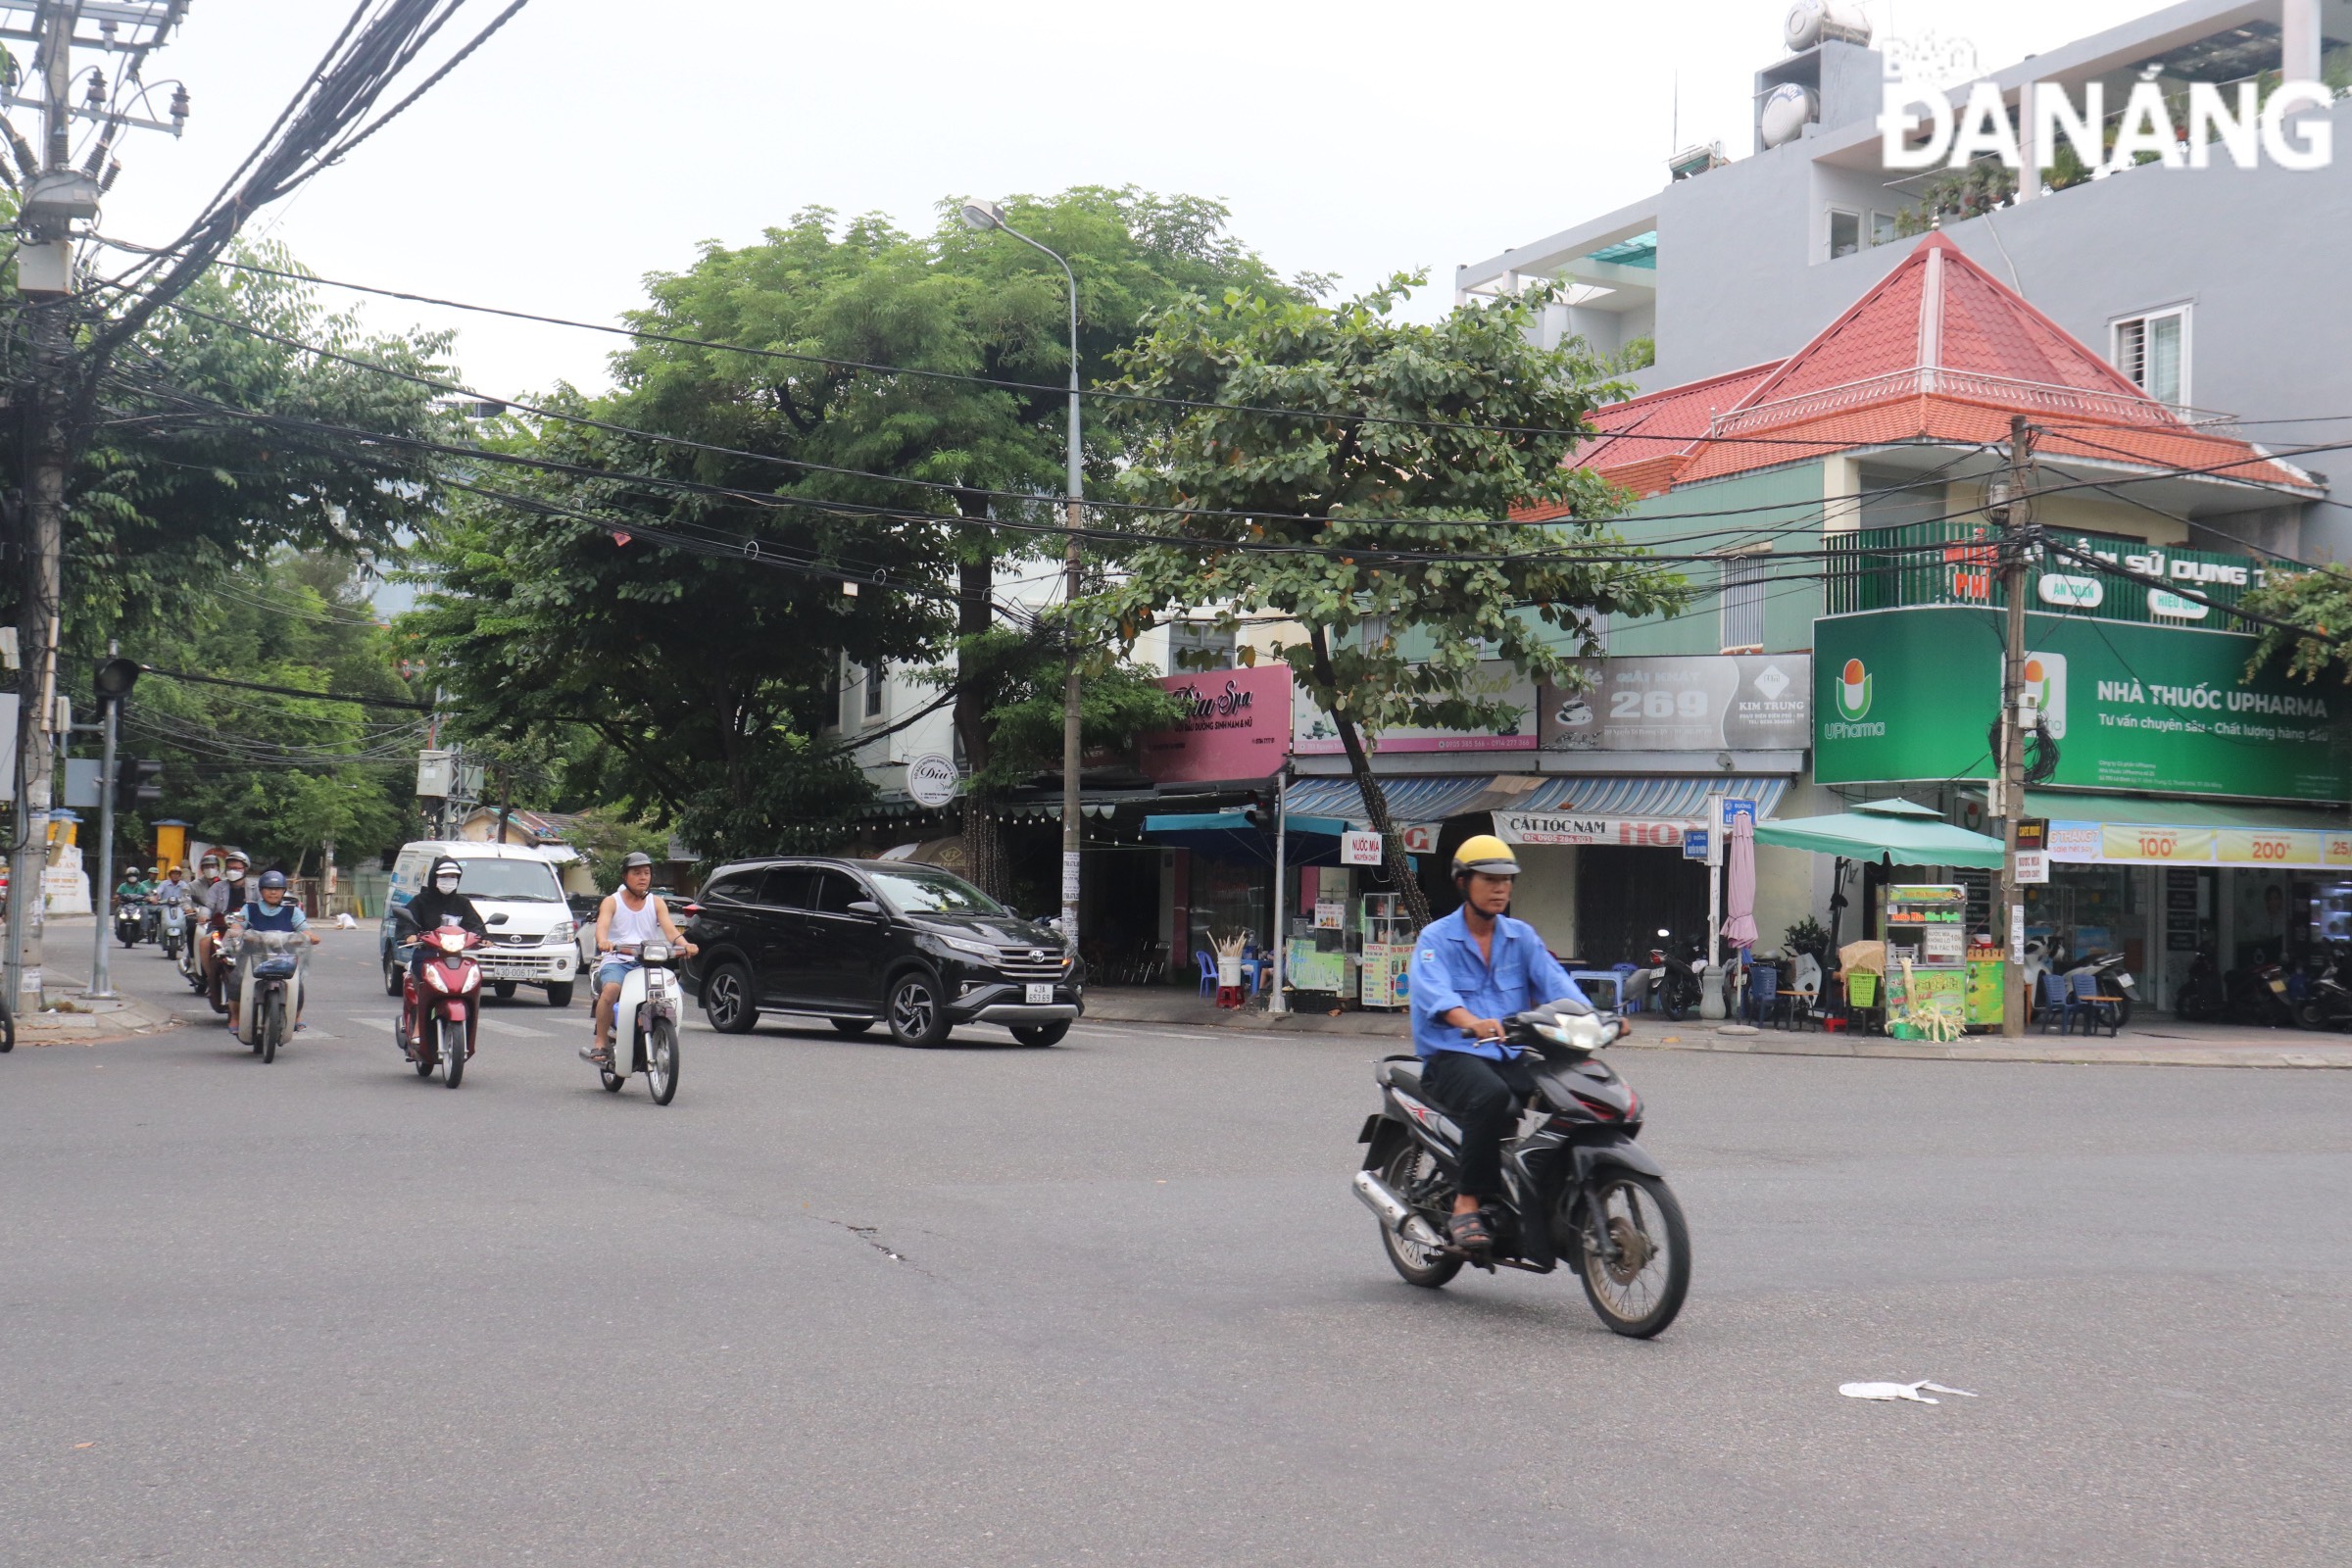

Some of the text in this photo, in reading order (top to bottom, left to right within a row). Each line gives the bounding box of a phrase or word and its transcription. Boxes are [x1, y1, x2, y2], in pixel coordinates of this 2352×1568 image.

[2125, 550, 2165, 576] SỬ
[2171, 560, 2247, 586] DỤNG
[2054, 581, 2094, 599] AN TOÀN
[2158, 594, 2179, 610] HIỆU
[1218, 679, 1253, 715] Spa
[1610, 690, 1708, 718] 269
[1739, 701, 1805, 710] KIM TRUNG
[2098, 677, 2328, 718] NHÀ THUỐC UPHARMA
[1825, 721, 1886, 740] UPharma
[2099, 712, 2115, 726] Tư
[2117, 713, 2137, 727] vấn
[2140, 716, 2182, 733] chuyên
[2185, 720, 2206, 733] sâu
[2215, 721, 2241, 735] Chất
[2243, 724, 2276, 740] lượng
[2278, 726, 2306, 743] hàng
[1510, 816, 1606, 833] CẮT TÓC NAM
[1352, 837, 1380, 853] NƯỚC MÍA
[1538, 834, 1558, 843] 0905
[1033, 985, 1047, 994] 43A
